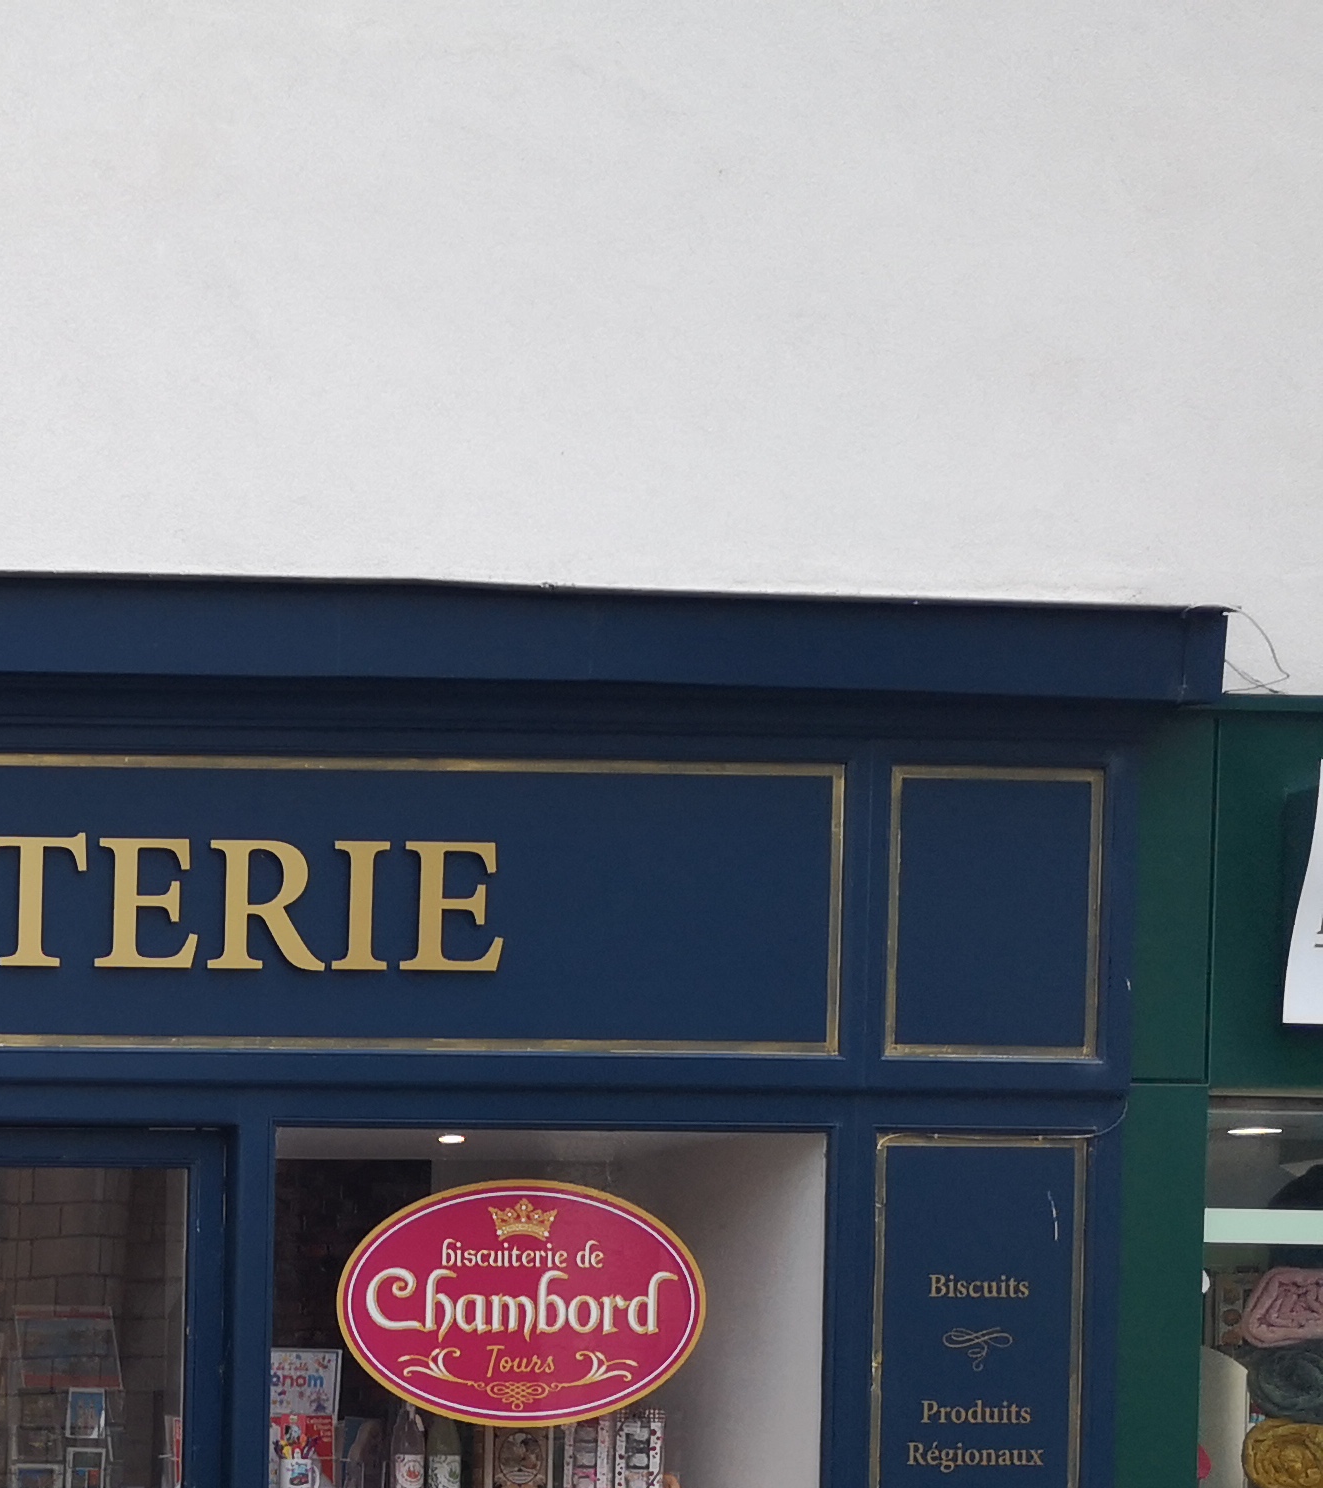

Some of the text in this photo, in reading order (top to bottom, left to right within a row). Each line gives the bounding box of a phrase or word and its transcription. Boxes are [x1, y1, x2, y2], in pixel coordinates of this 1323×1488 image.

[441, 1239, 604, 1268] biscuiterie de
[928, 1274, 1029, 1299] Biscuits
[365, 1267, 679, 1342] Chambord
[485, 1346, 555, 1378] Tours
[920, 1400, 1031, 1425] Produits
[907, 1441, 1044, 1471] Régionaux
